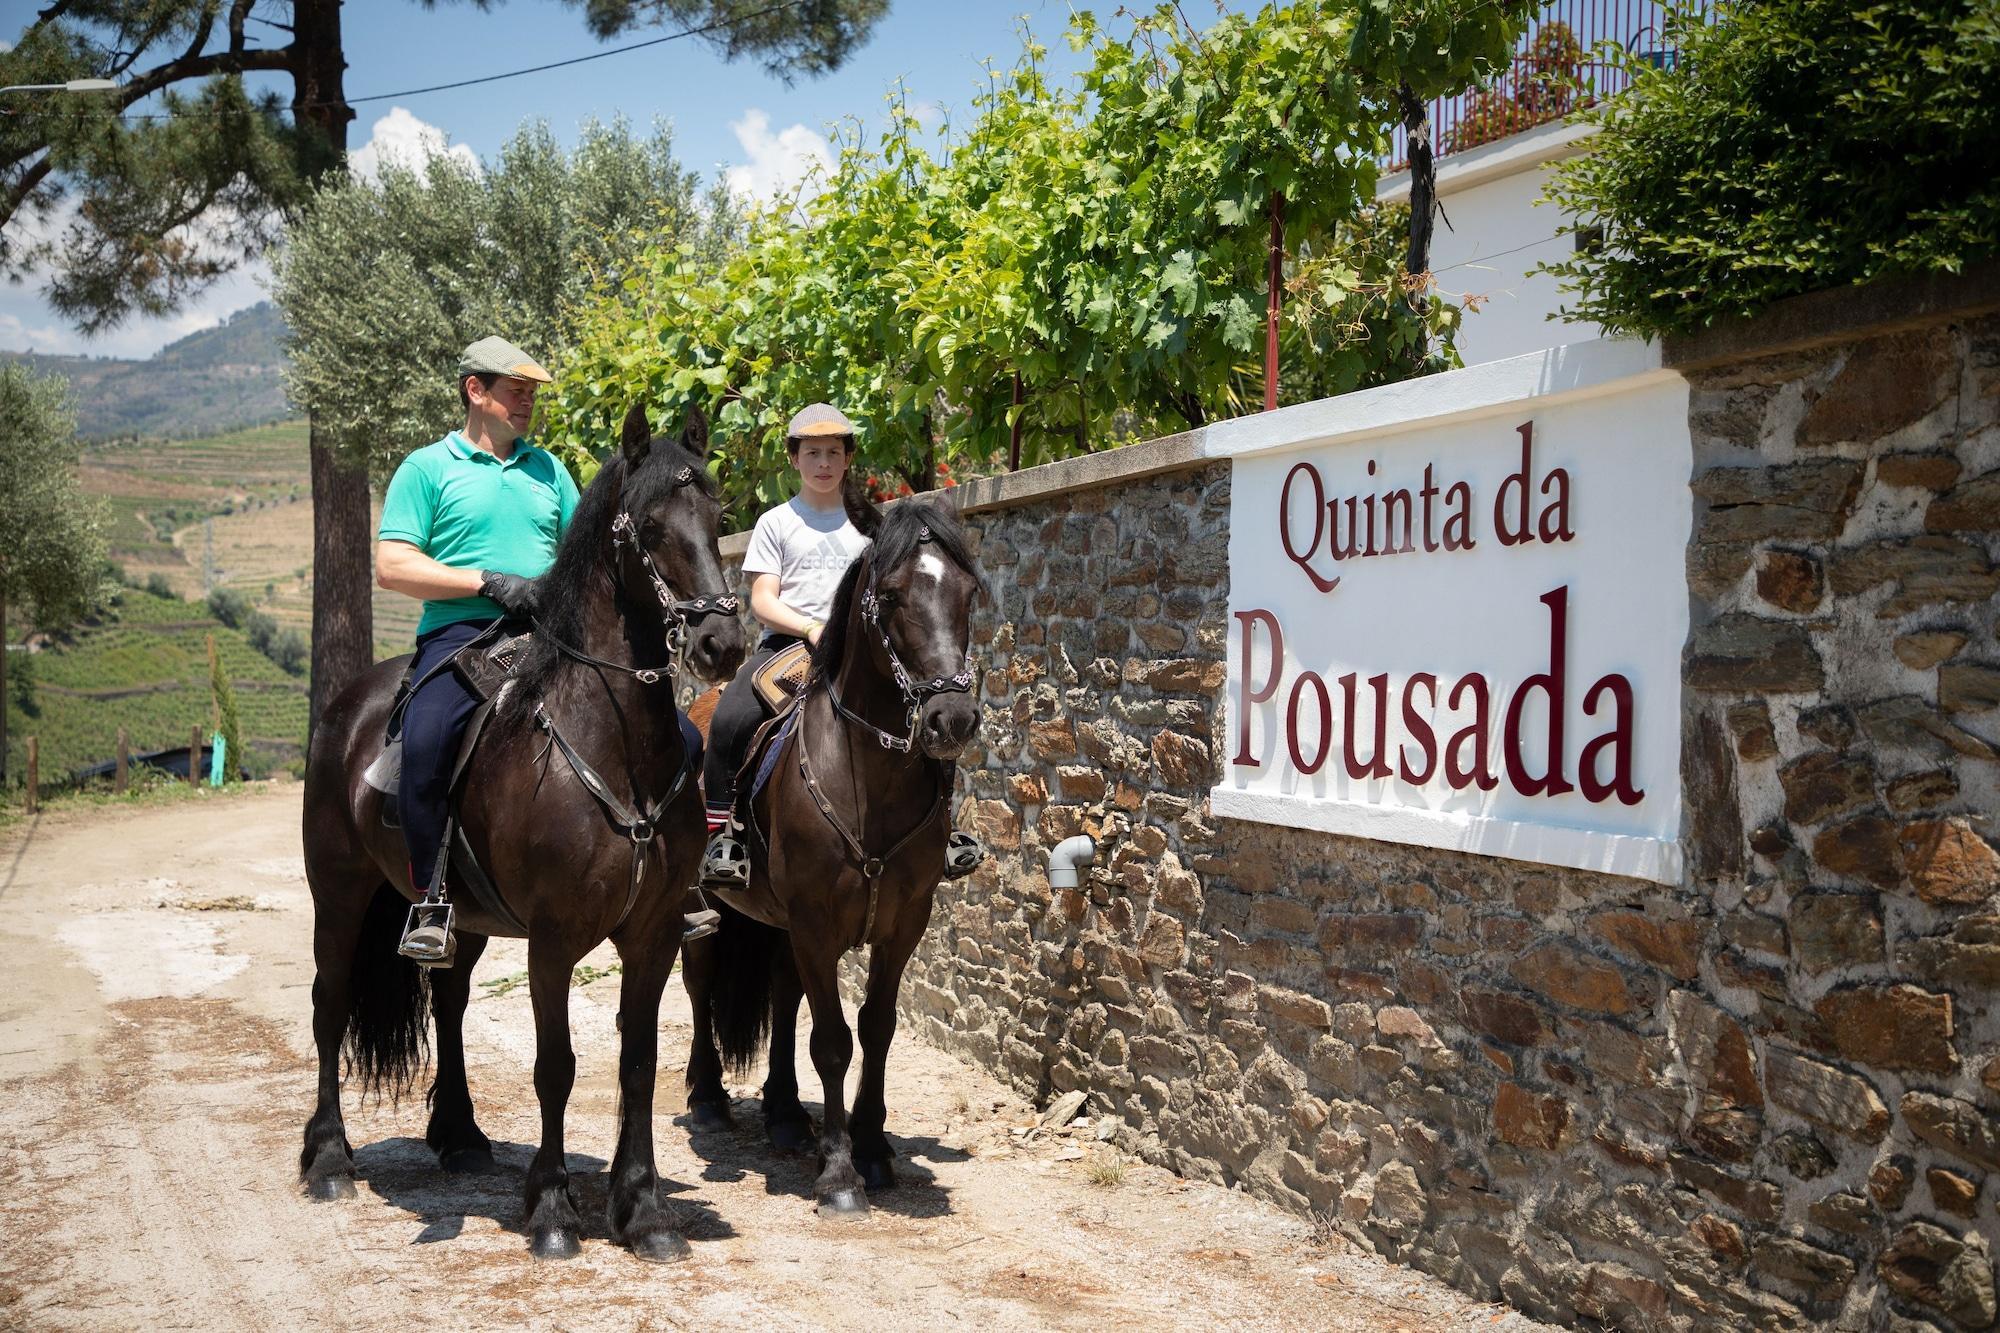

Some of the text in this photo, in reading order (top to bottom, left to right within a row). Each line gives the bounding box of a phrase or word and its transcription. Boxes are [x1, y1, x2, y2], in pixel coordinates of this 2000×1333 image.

[1280, 420, 1575, 593] Quinta da
[1232, 585, 1645, 805] Pousada
